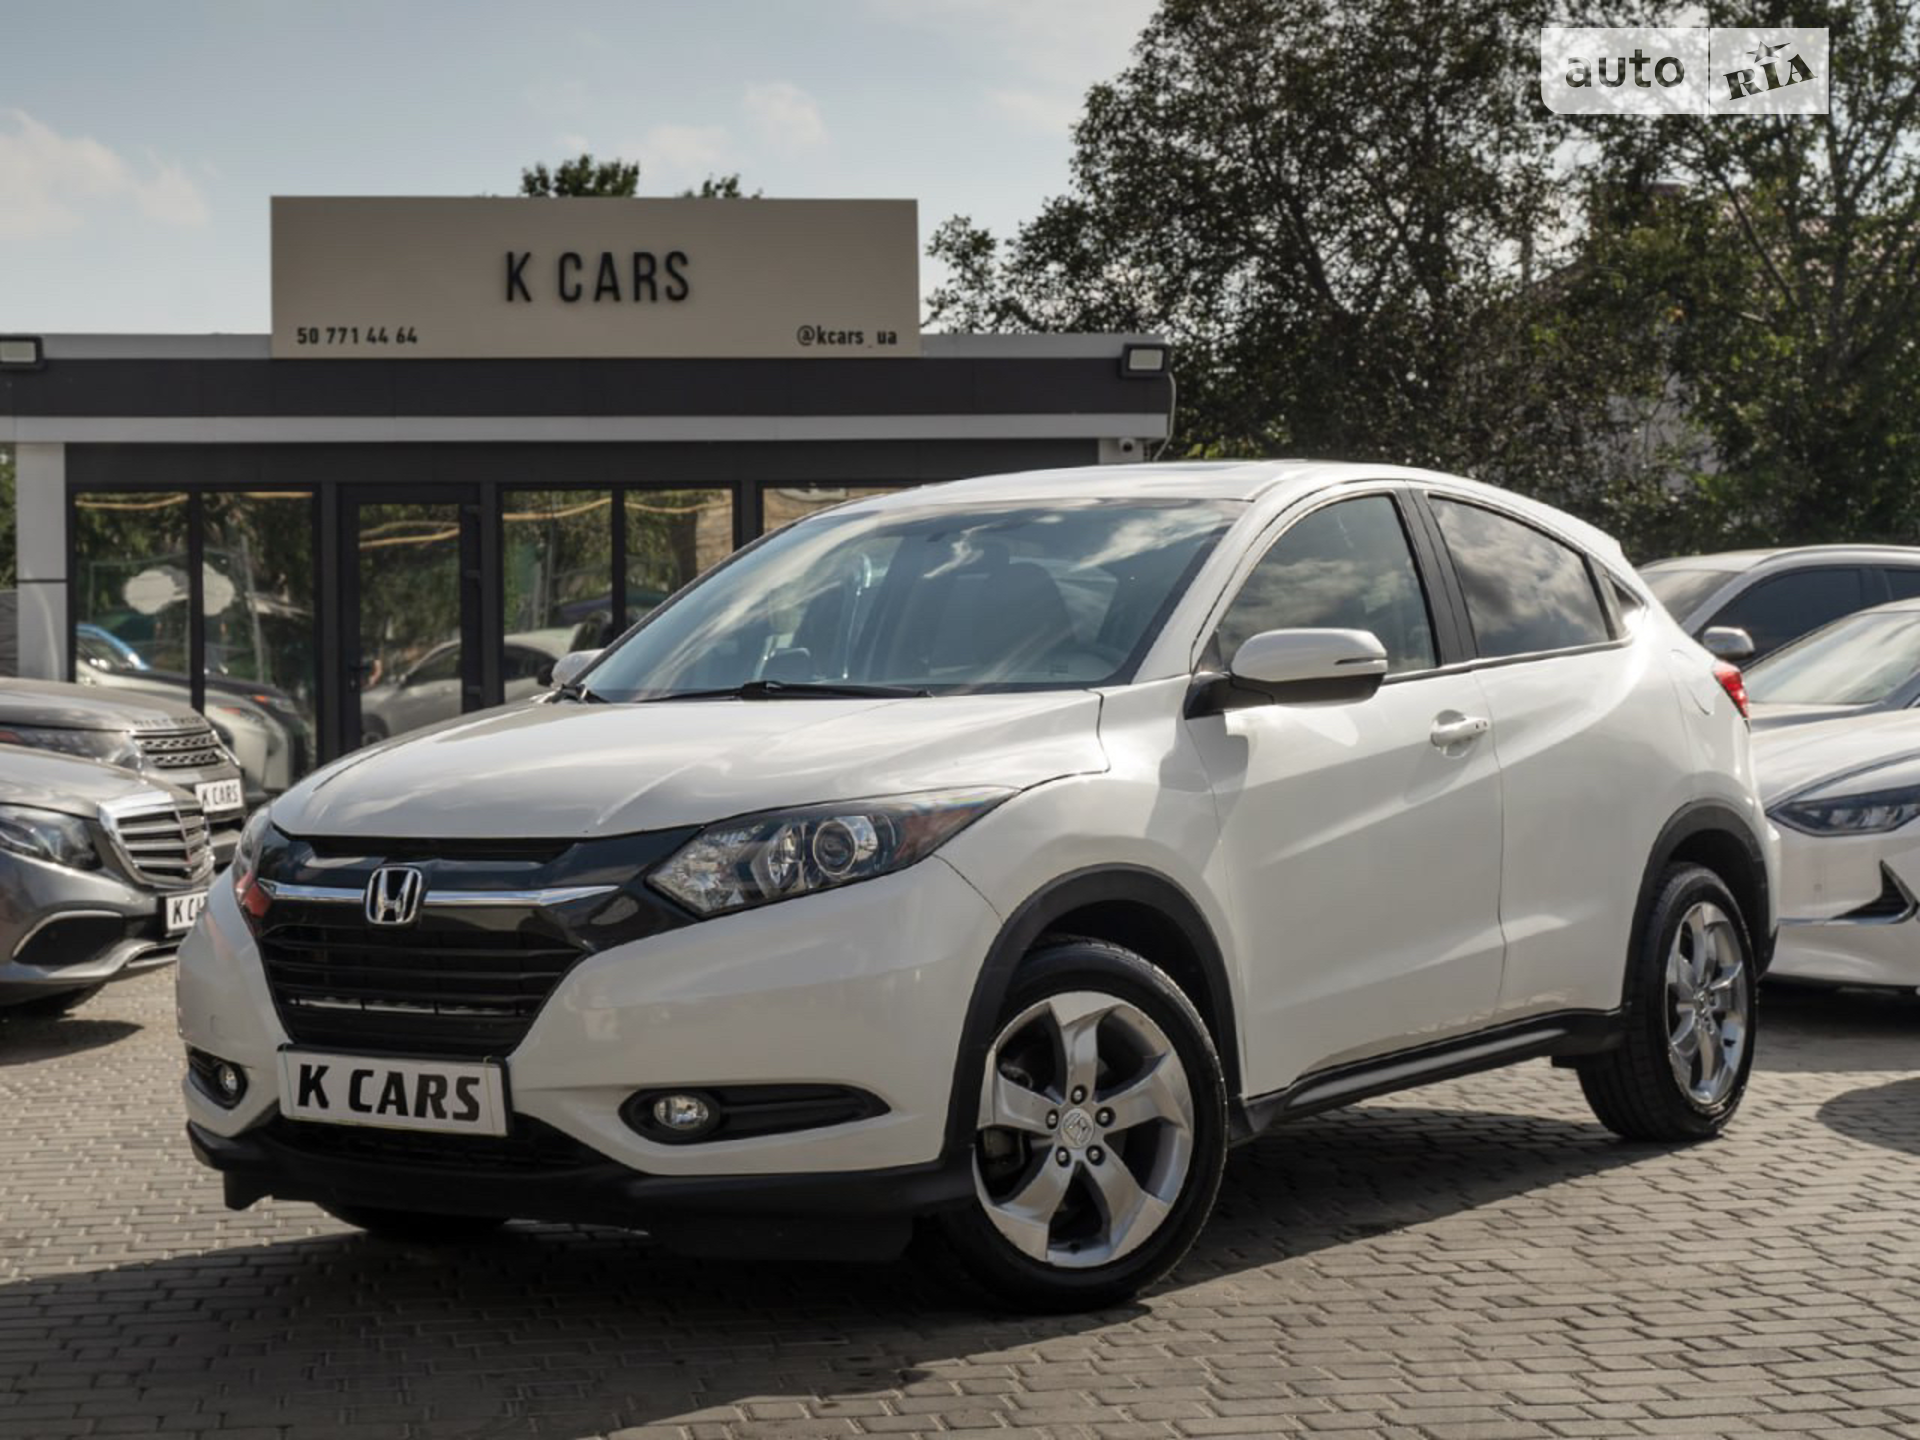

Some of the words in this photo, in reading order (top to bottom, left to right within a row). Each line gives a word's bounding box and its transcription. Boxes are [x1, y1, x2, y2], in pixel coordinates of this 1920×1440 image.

[506, 251, 532, 302] K
[558, 250, 689, 302] CARS
[296, 326, 319, 344] 50
[326, 326, 358, 344] 771
[366, 326, 388, 344] 44
[396, 326, 417, 344] 64
[212, 784, 238, 805] CARS
[173, 899, 183, 924] K
[298, 1064, 330, 1109] K
[348, 1068, 480, 1122] CARS
